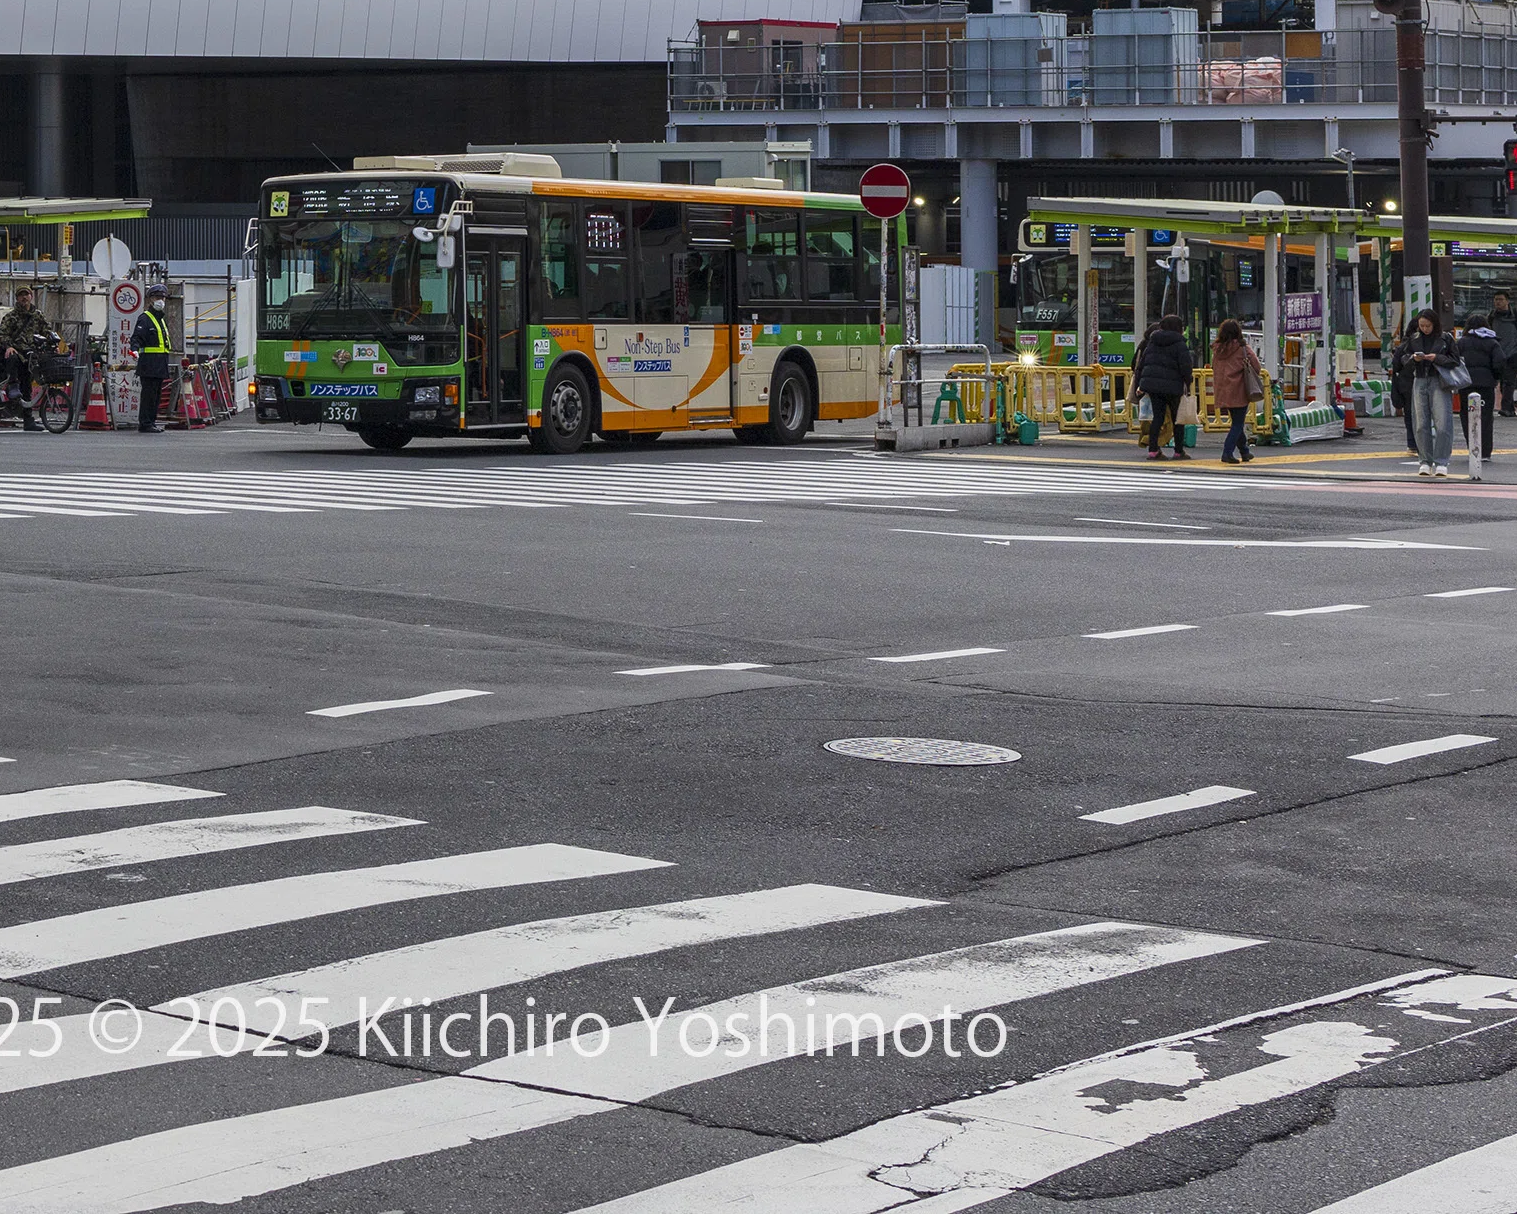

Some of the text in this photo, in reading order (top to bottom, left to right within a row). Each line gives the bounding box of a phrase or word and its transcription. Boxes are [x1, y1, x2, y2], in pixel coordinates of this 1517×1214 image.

[266, 313, 290, 330] H864
[1036, 308, 1059, 321] F557
[666, 338, 680, 354] Bus
[311, 384, 378, 396] ノンステップバス
